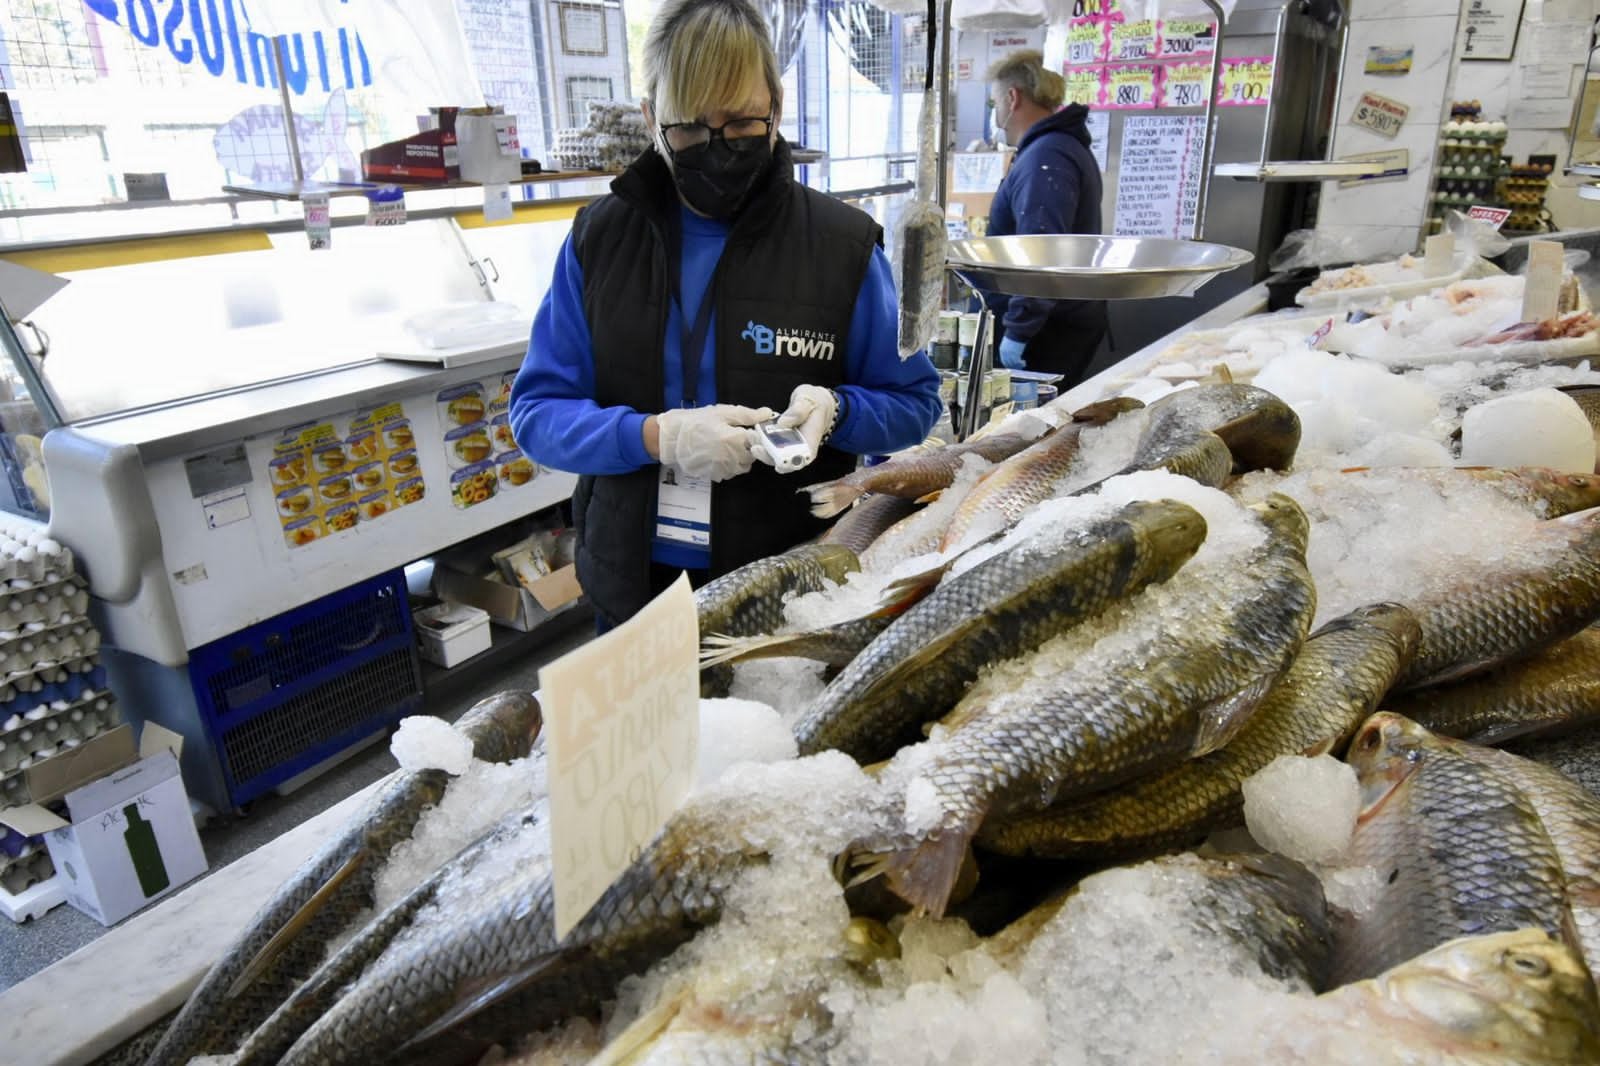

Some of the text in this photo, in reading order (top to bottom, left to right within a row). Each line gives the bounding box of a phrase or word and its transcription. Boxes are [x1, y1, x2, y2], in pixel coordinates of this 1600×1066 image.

[1117, 84, 1141, 105] 880
[1174, 83, 1201, 106] 780
[754, 325, 835, 361] Brown
[776, 327, 836, 342] ALMIRANTE
